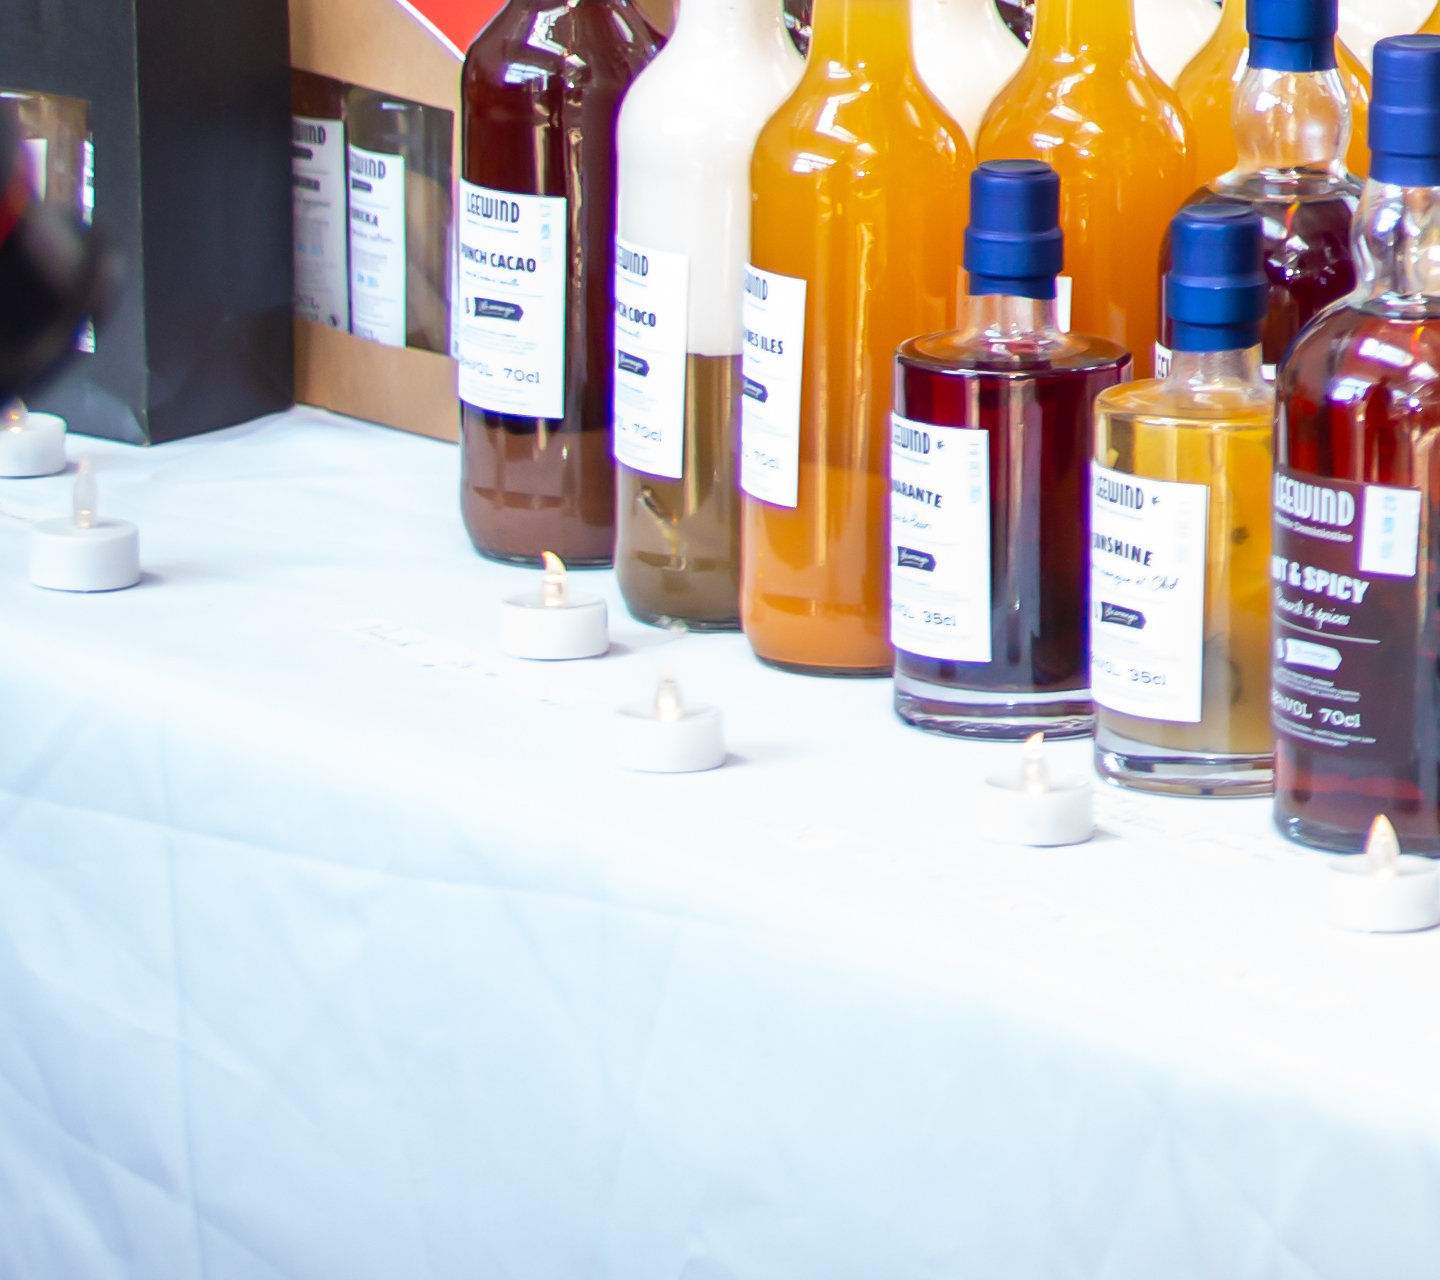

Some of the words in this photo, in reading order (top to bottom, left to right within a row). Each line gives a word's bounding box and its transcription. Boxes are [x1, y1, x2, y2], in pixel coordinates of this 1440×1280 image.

[466, 191, 520, 224] LEEWIND
[491, 251, 537, 273] CACAO
[629, 306, 657, 328] COCO
[503, 367, 540, 384] 70cl
[1274, 471, 1355, 528] LEEWIND
[1302, 565, 1370, 605] SPICY
[1319, 707, 1361, 728] 70cl
